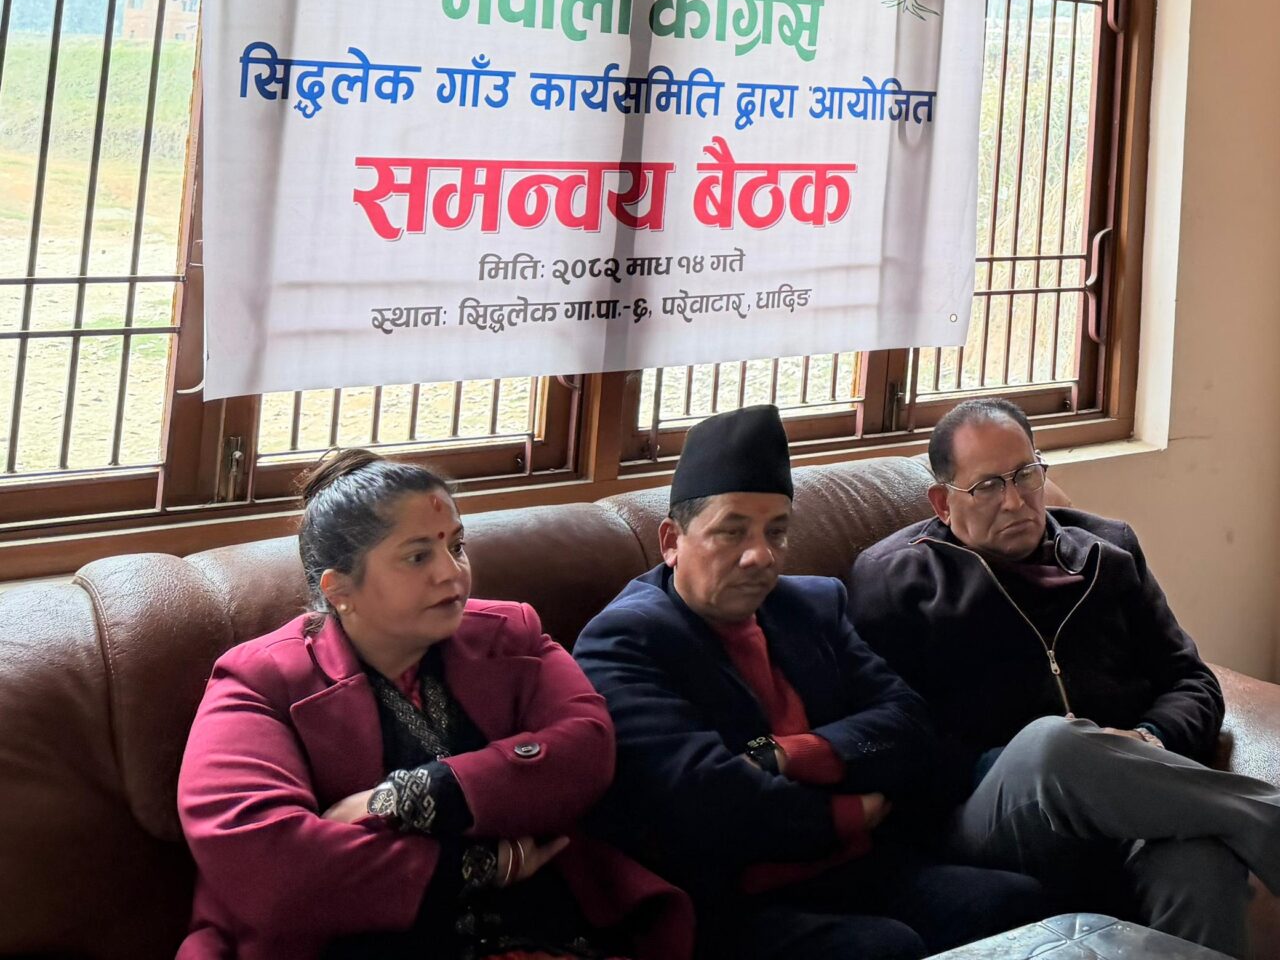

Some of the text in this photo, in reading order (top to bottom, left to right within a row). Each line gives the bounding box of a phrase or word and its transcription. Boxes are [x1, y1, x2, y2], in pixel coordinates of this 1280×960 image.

[239, 41, 938, 131] सिद्धलेक गाँउ कार्यसमिति द्वारा आयोजित
[353, 135, 858, 242] समन्वय बैठक
[551, 257, 623, 285] २०८२
[677, 254, 705, 274] १४
[710, 247, 747, 273] गते
[458, 295, 561, 333] सिद्धलेक
[756, 283, 814, 314] धादिङ
